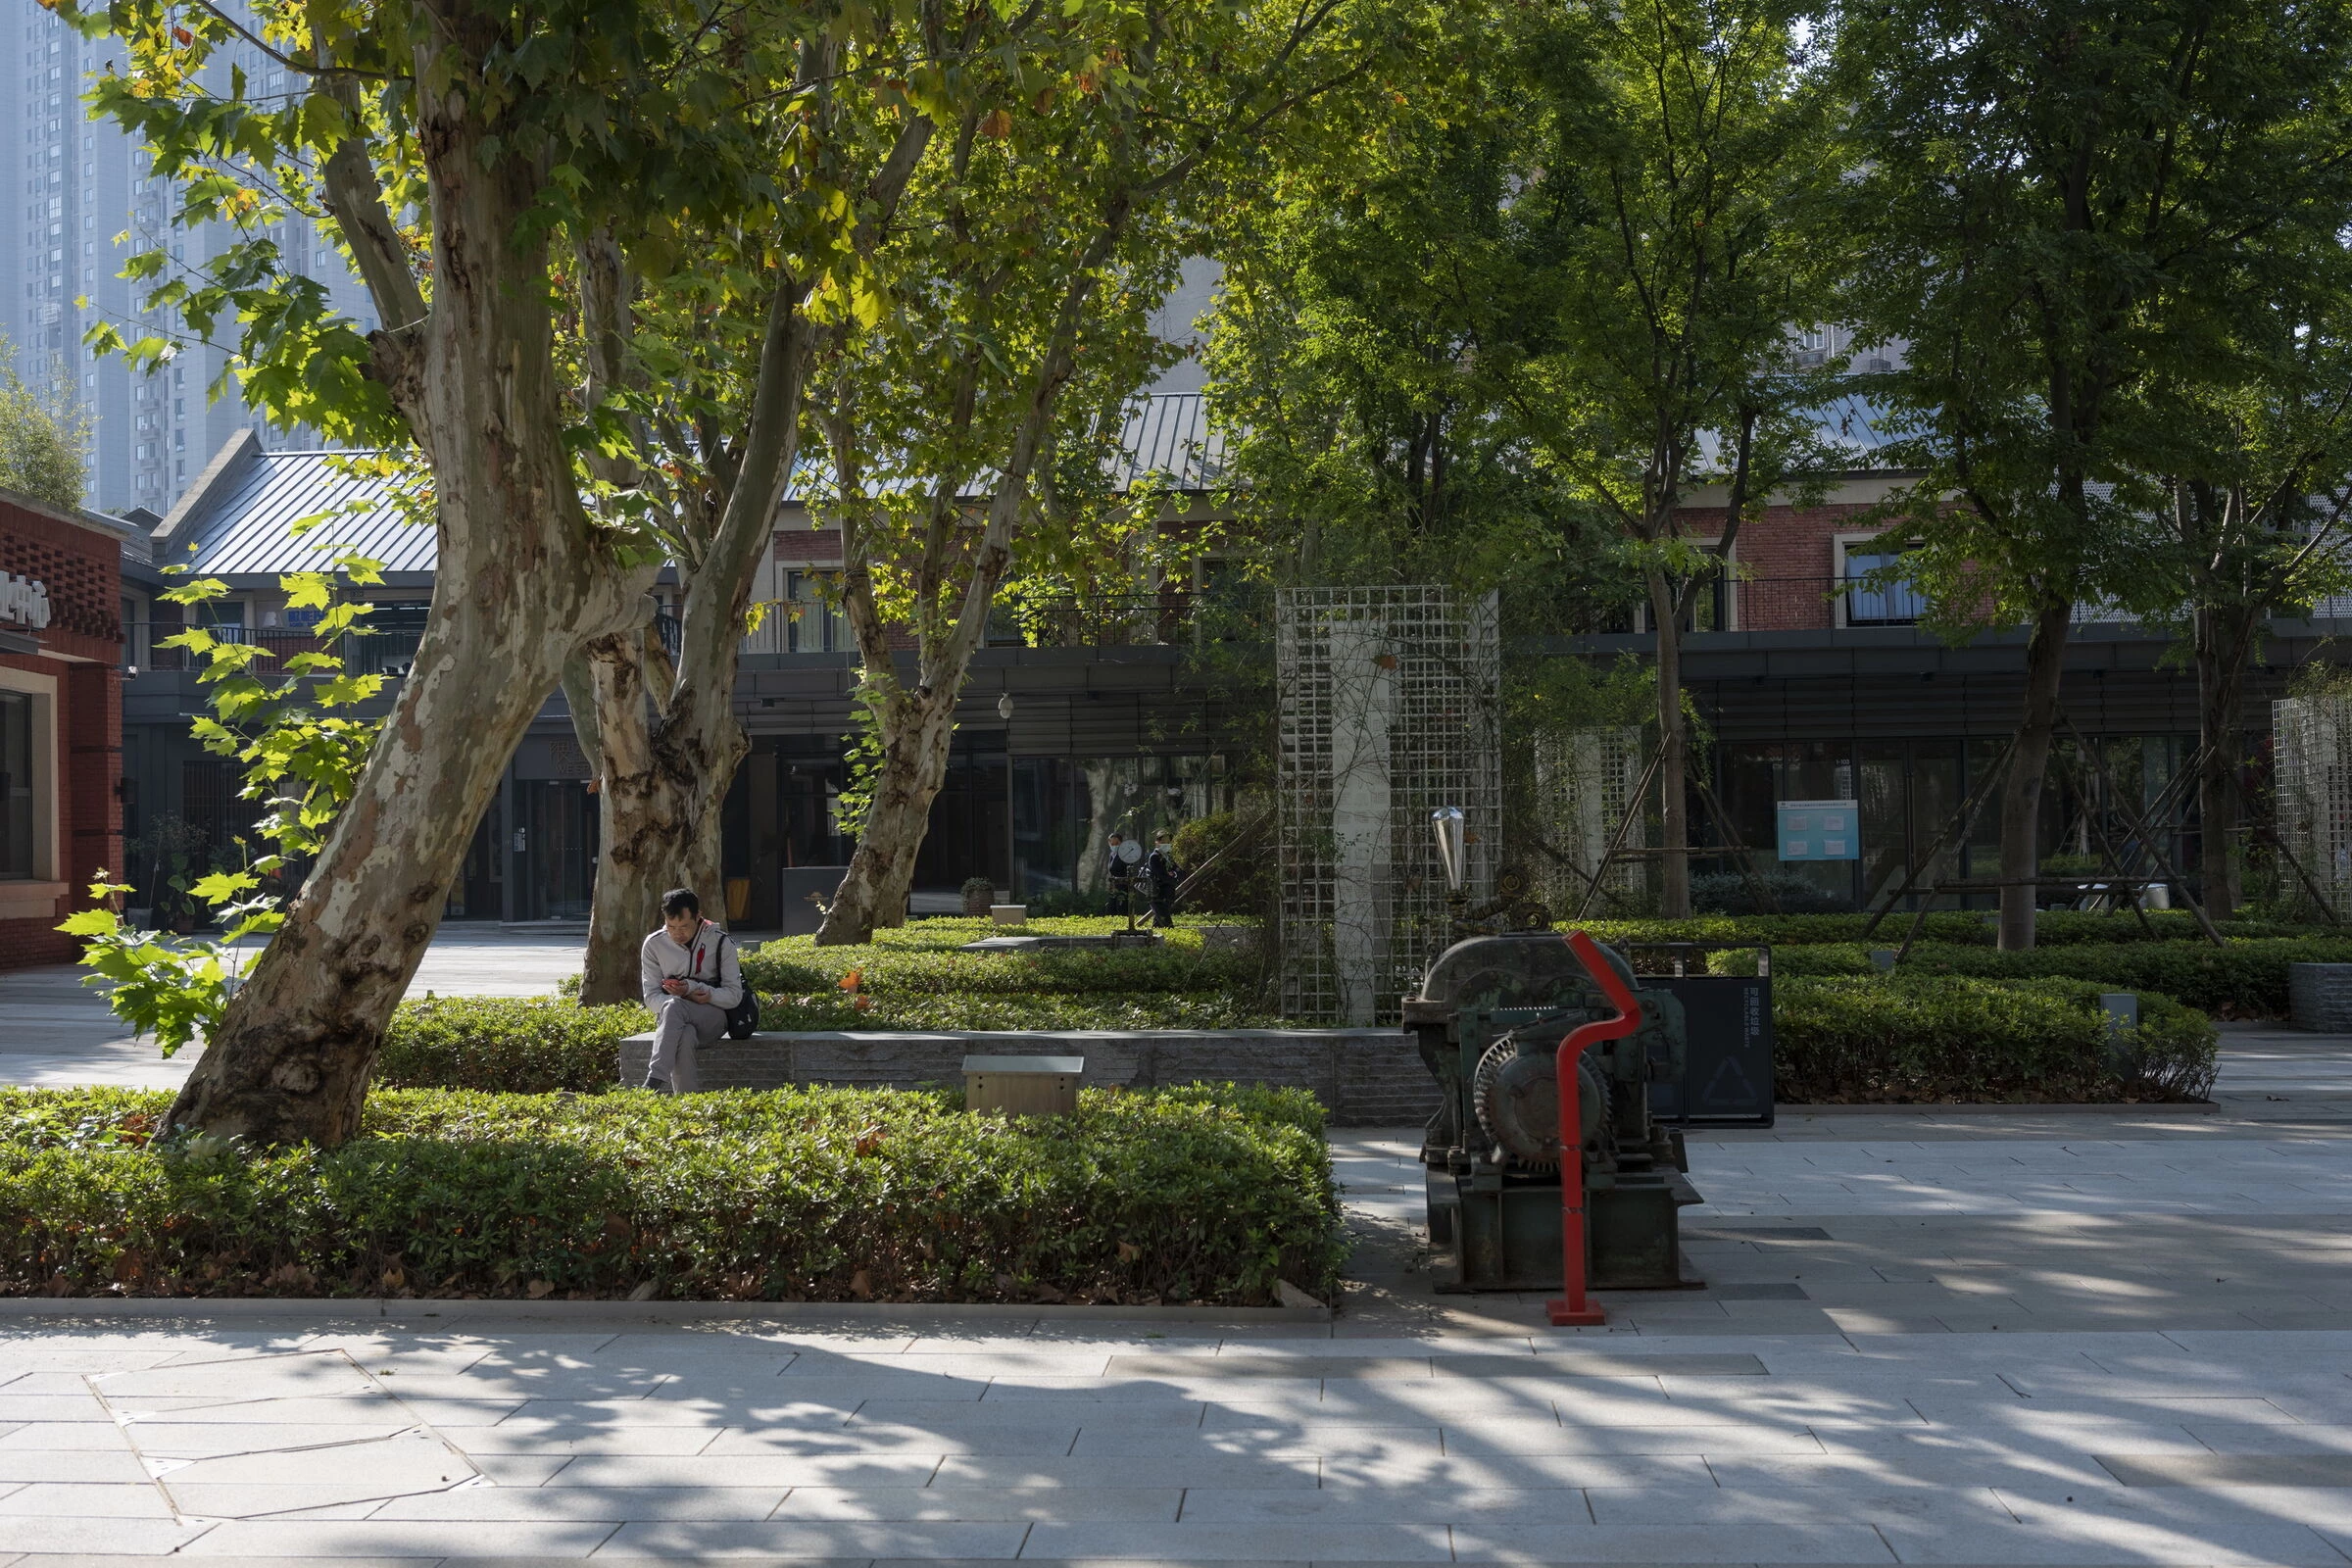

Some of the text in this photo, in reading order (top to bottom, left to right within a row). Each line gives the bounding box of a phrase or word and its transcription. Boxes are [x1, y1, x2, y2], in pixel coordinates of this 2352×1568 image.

[1749, 987, 1760, 1036] 可回收垃圾
